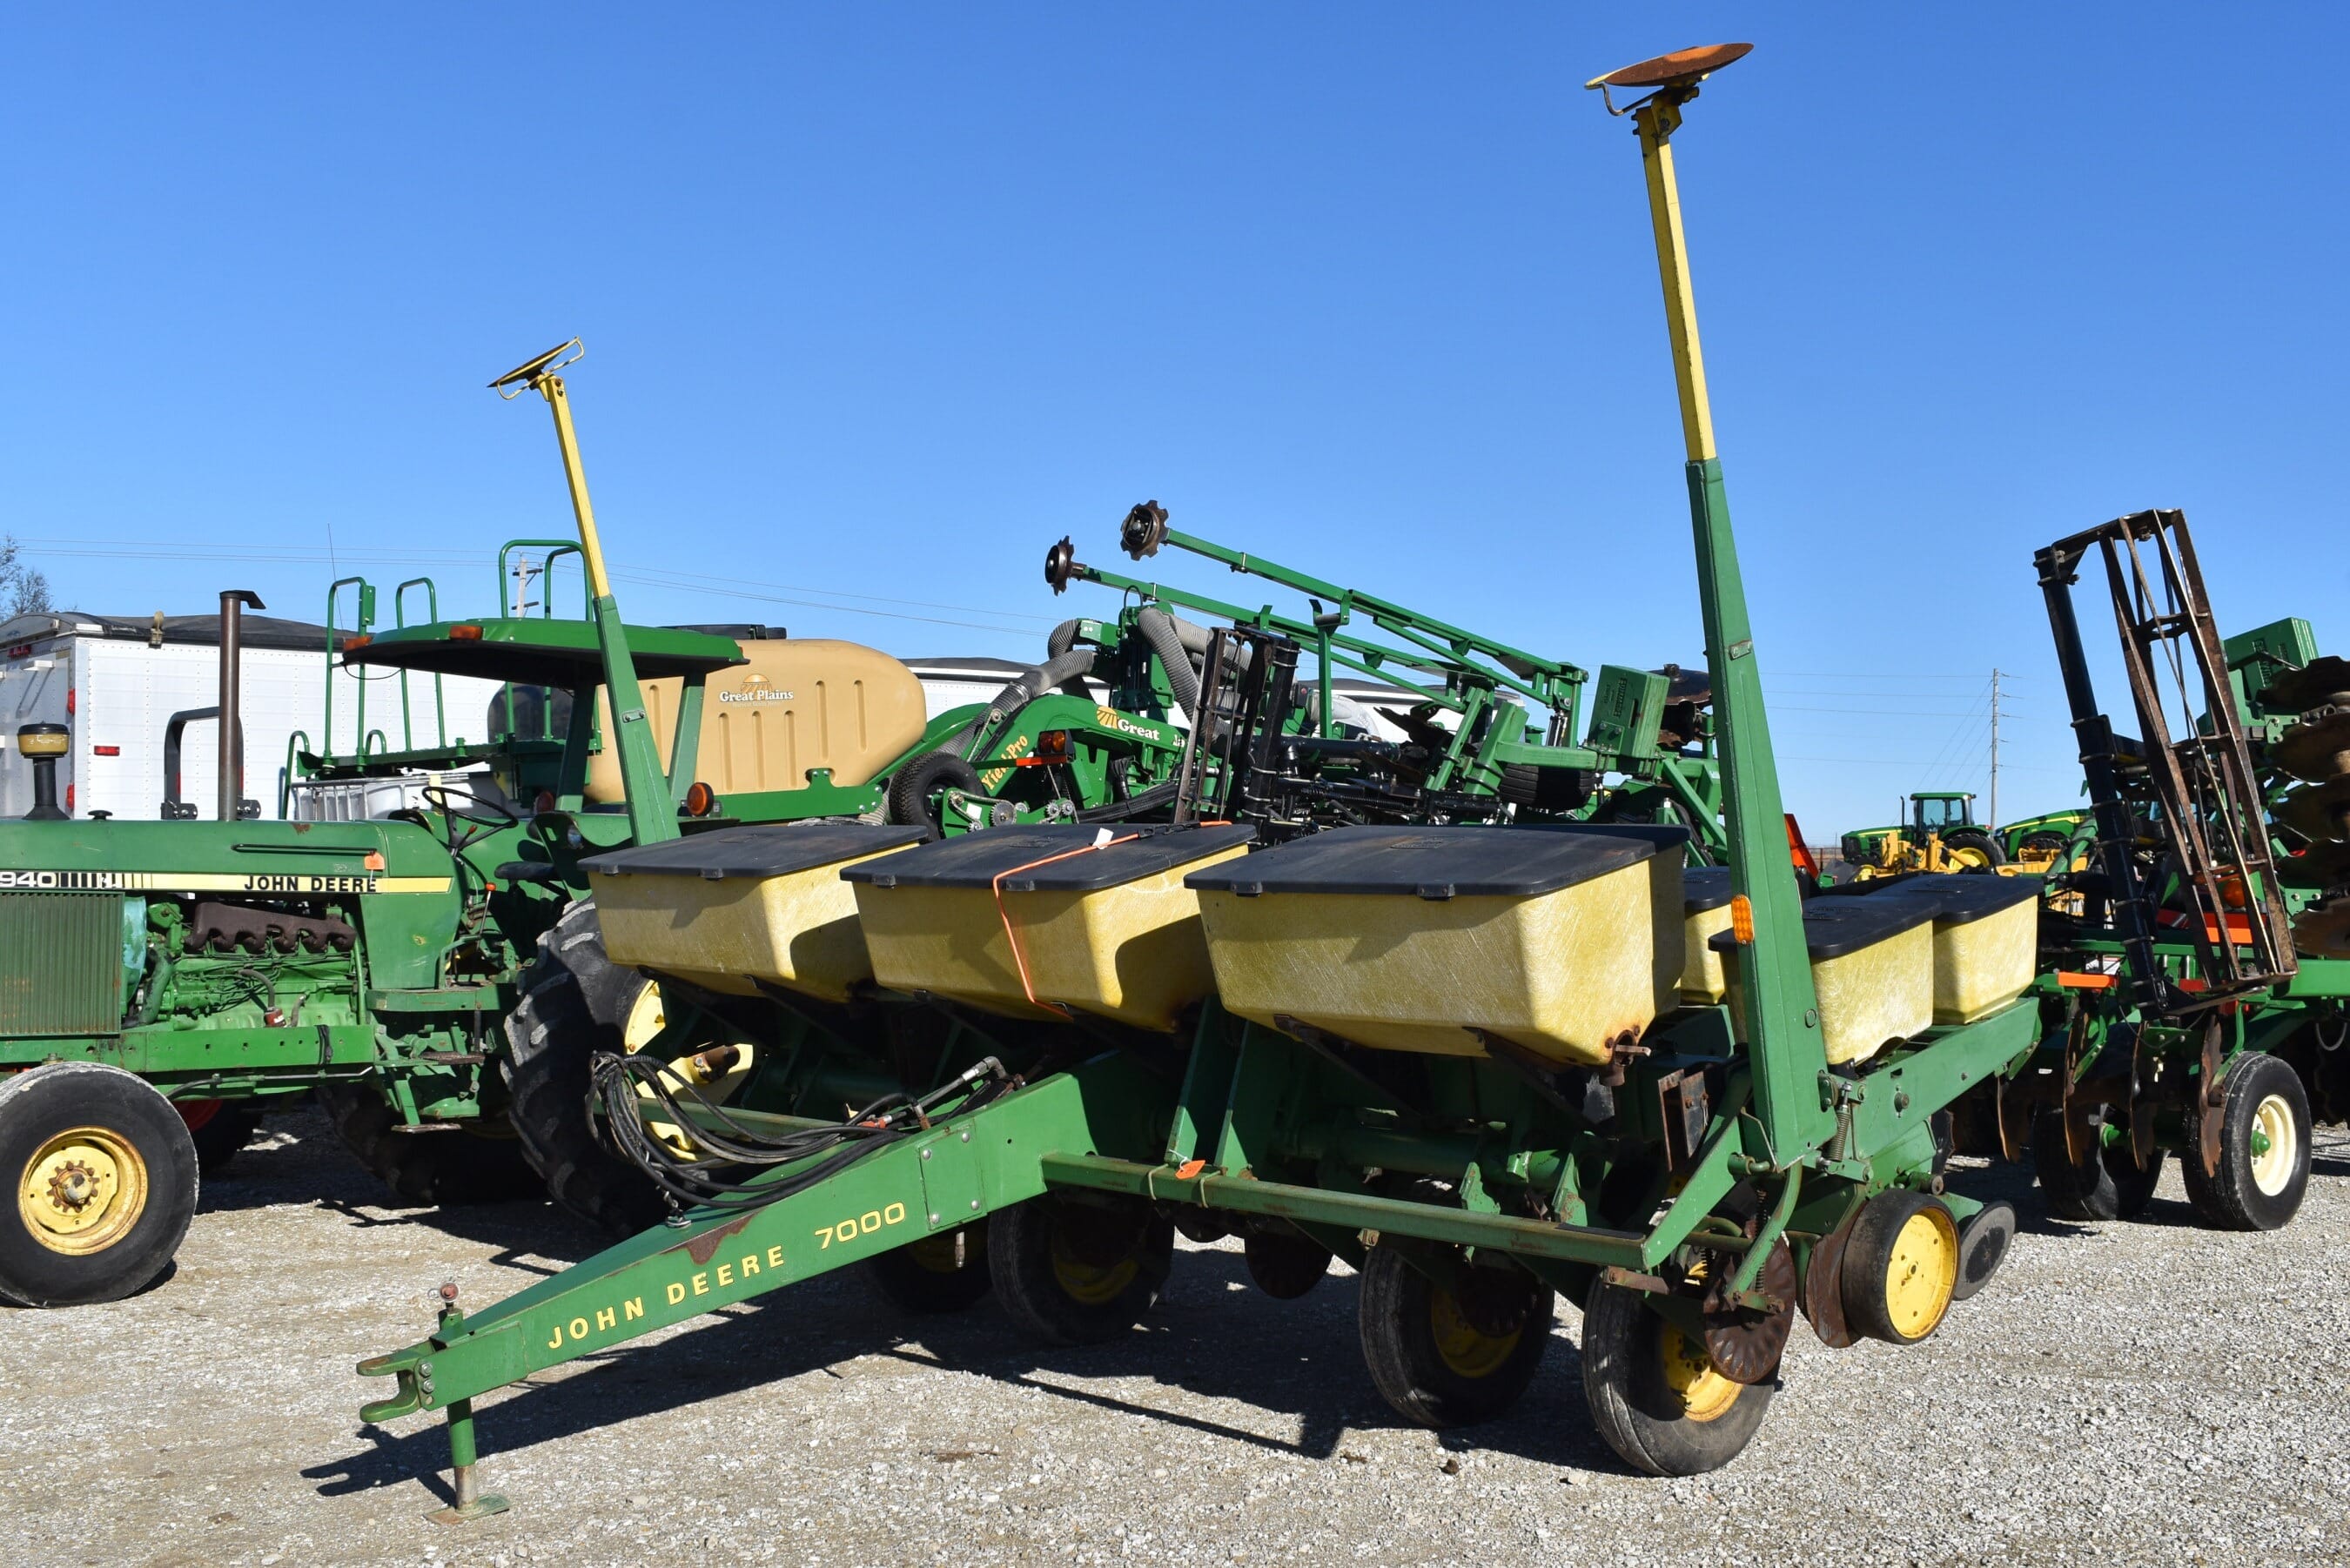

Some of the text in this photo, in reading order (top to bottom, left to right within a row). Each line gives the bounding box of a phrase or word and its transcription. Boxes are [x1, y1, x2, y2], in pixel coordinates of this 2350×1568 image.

[720, 689, 795, 702] Great Plains
[1118, 719, 1160, 741] Great
[981, 735, 1029, 790] Yie-Pro
[0, 871, 57, 888] 940
[244, 875, 377, 893] JOHN DEERE
[548, 1202, 906, 1350] JOHN DEERE 7000
